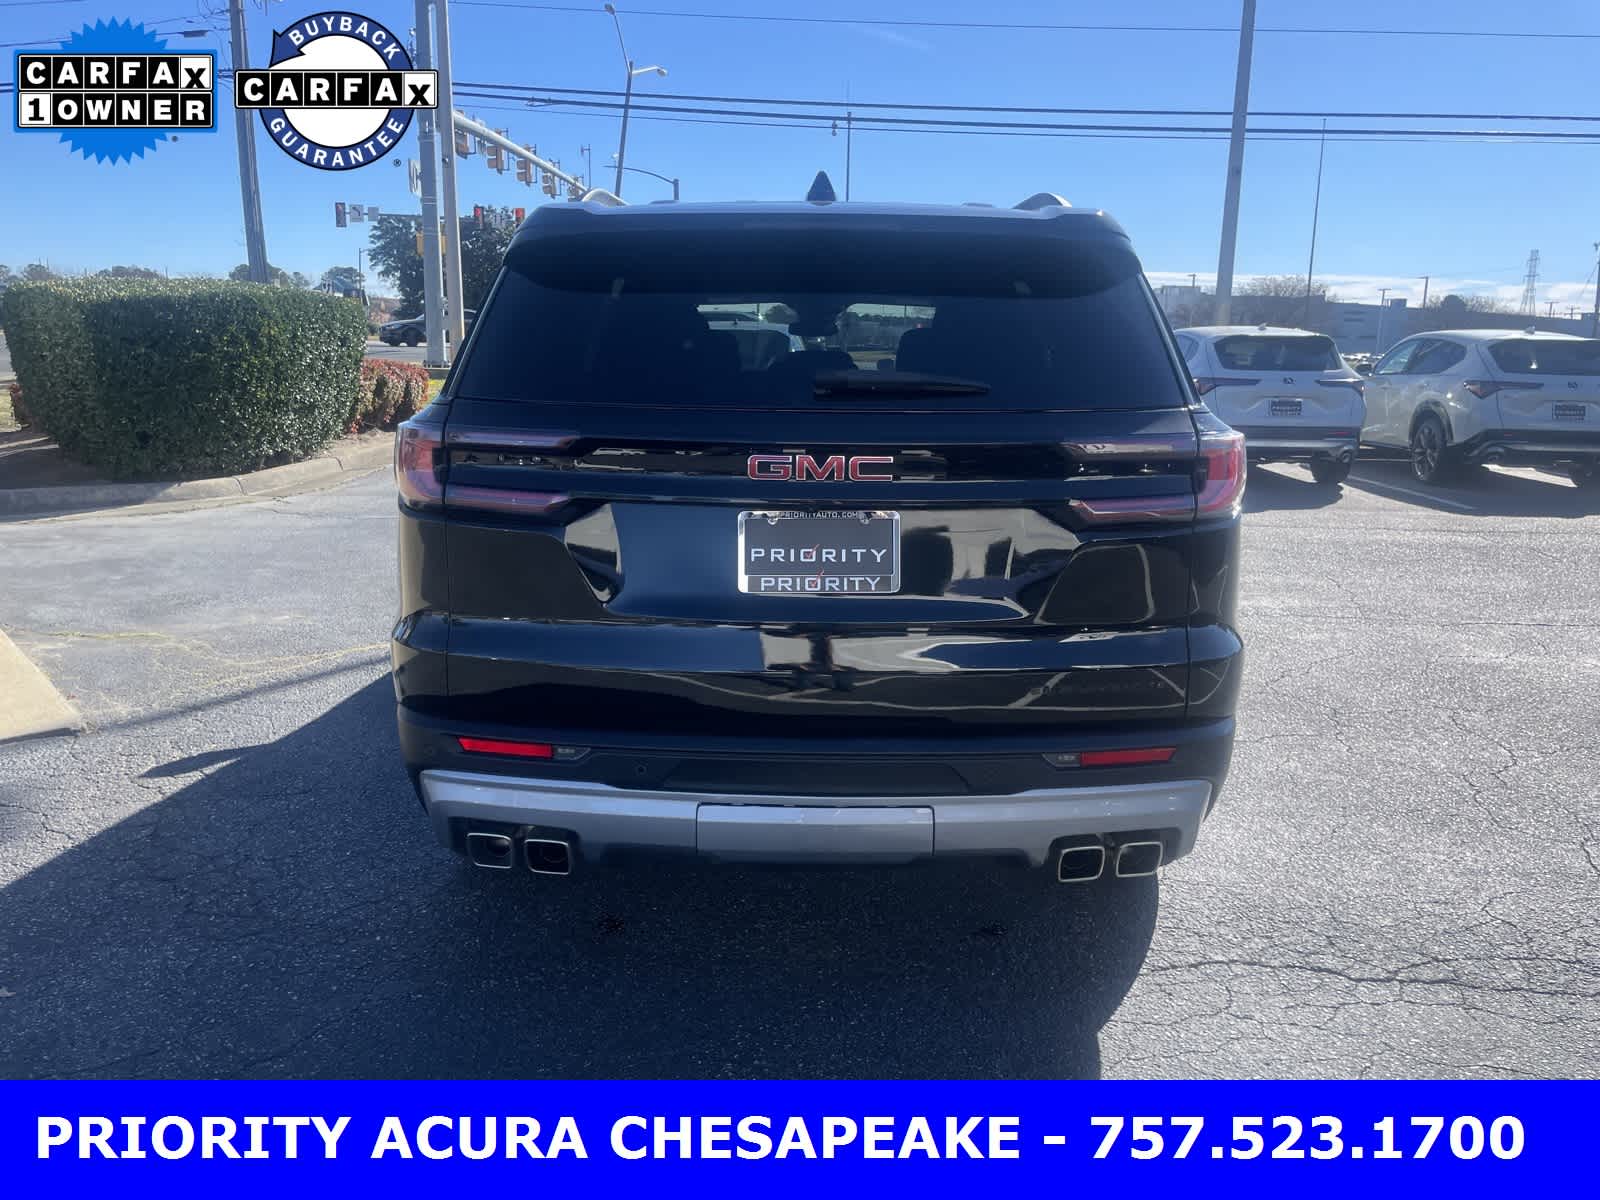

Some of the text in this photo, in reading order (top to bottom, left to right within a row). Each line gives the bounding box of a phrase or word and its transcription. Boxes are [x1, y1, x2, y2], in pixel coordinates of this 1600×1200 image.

[747, 455, 894, 481] GMC
[751, 548, 888, 562] PRIORITY
[760, 576, 881, 591] PRIORITY
